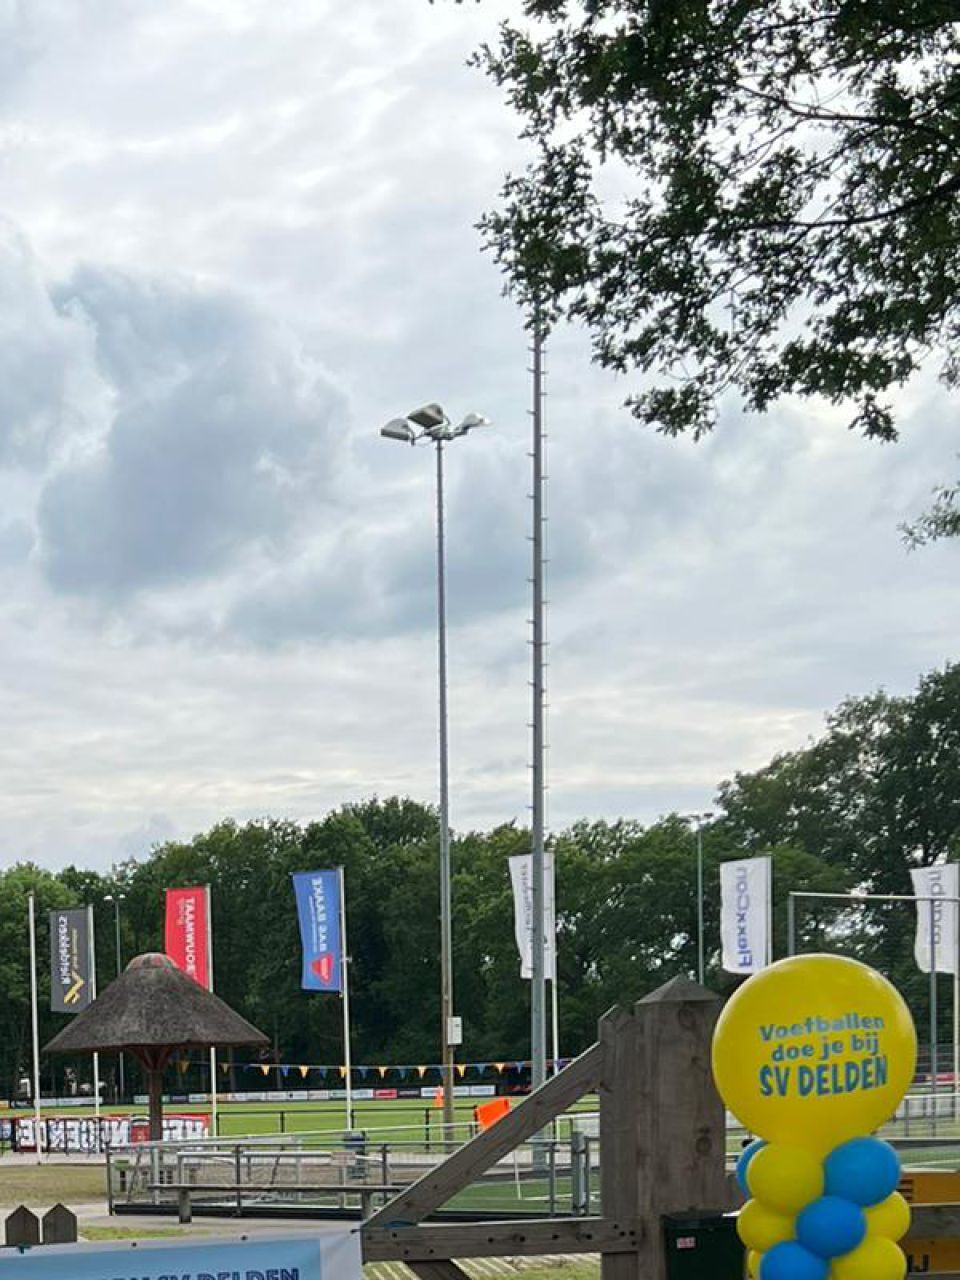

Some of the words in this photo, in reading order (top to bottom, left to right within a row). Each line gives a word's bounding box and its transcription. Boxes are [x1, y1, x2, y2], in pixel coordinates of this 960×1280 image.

[760, 1013, 885, 1042] Voetballen
[772, 1044, 814, 1062] doe
[819, 1036, 844, 1060] je
[851, 1031, 879, 1056] bij
[760, 1064, 790, 1097] SV
[798, 1055, 887, 1097] DELDEN
